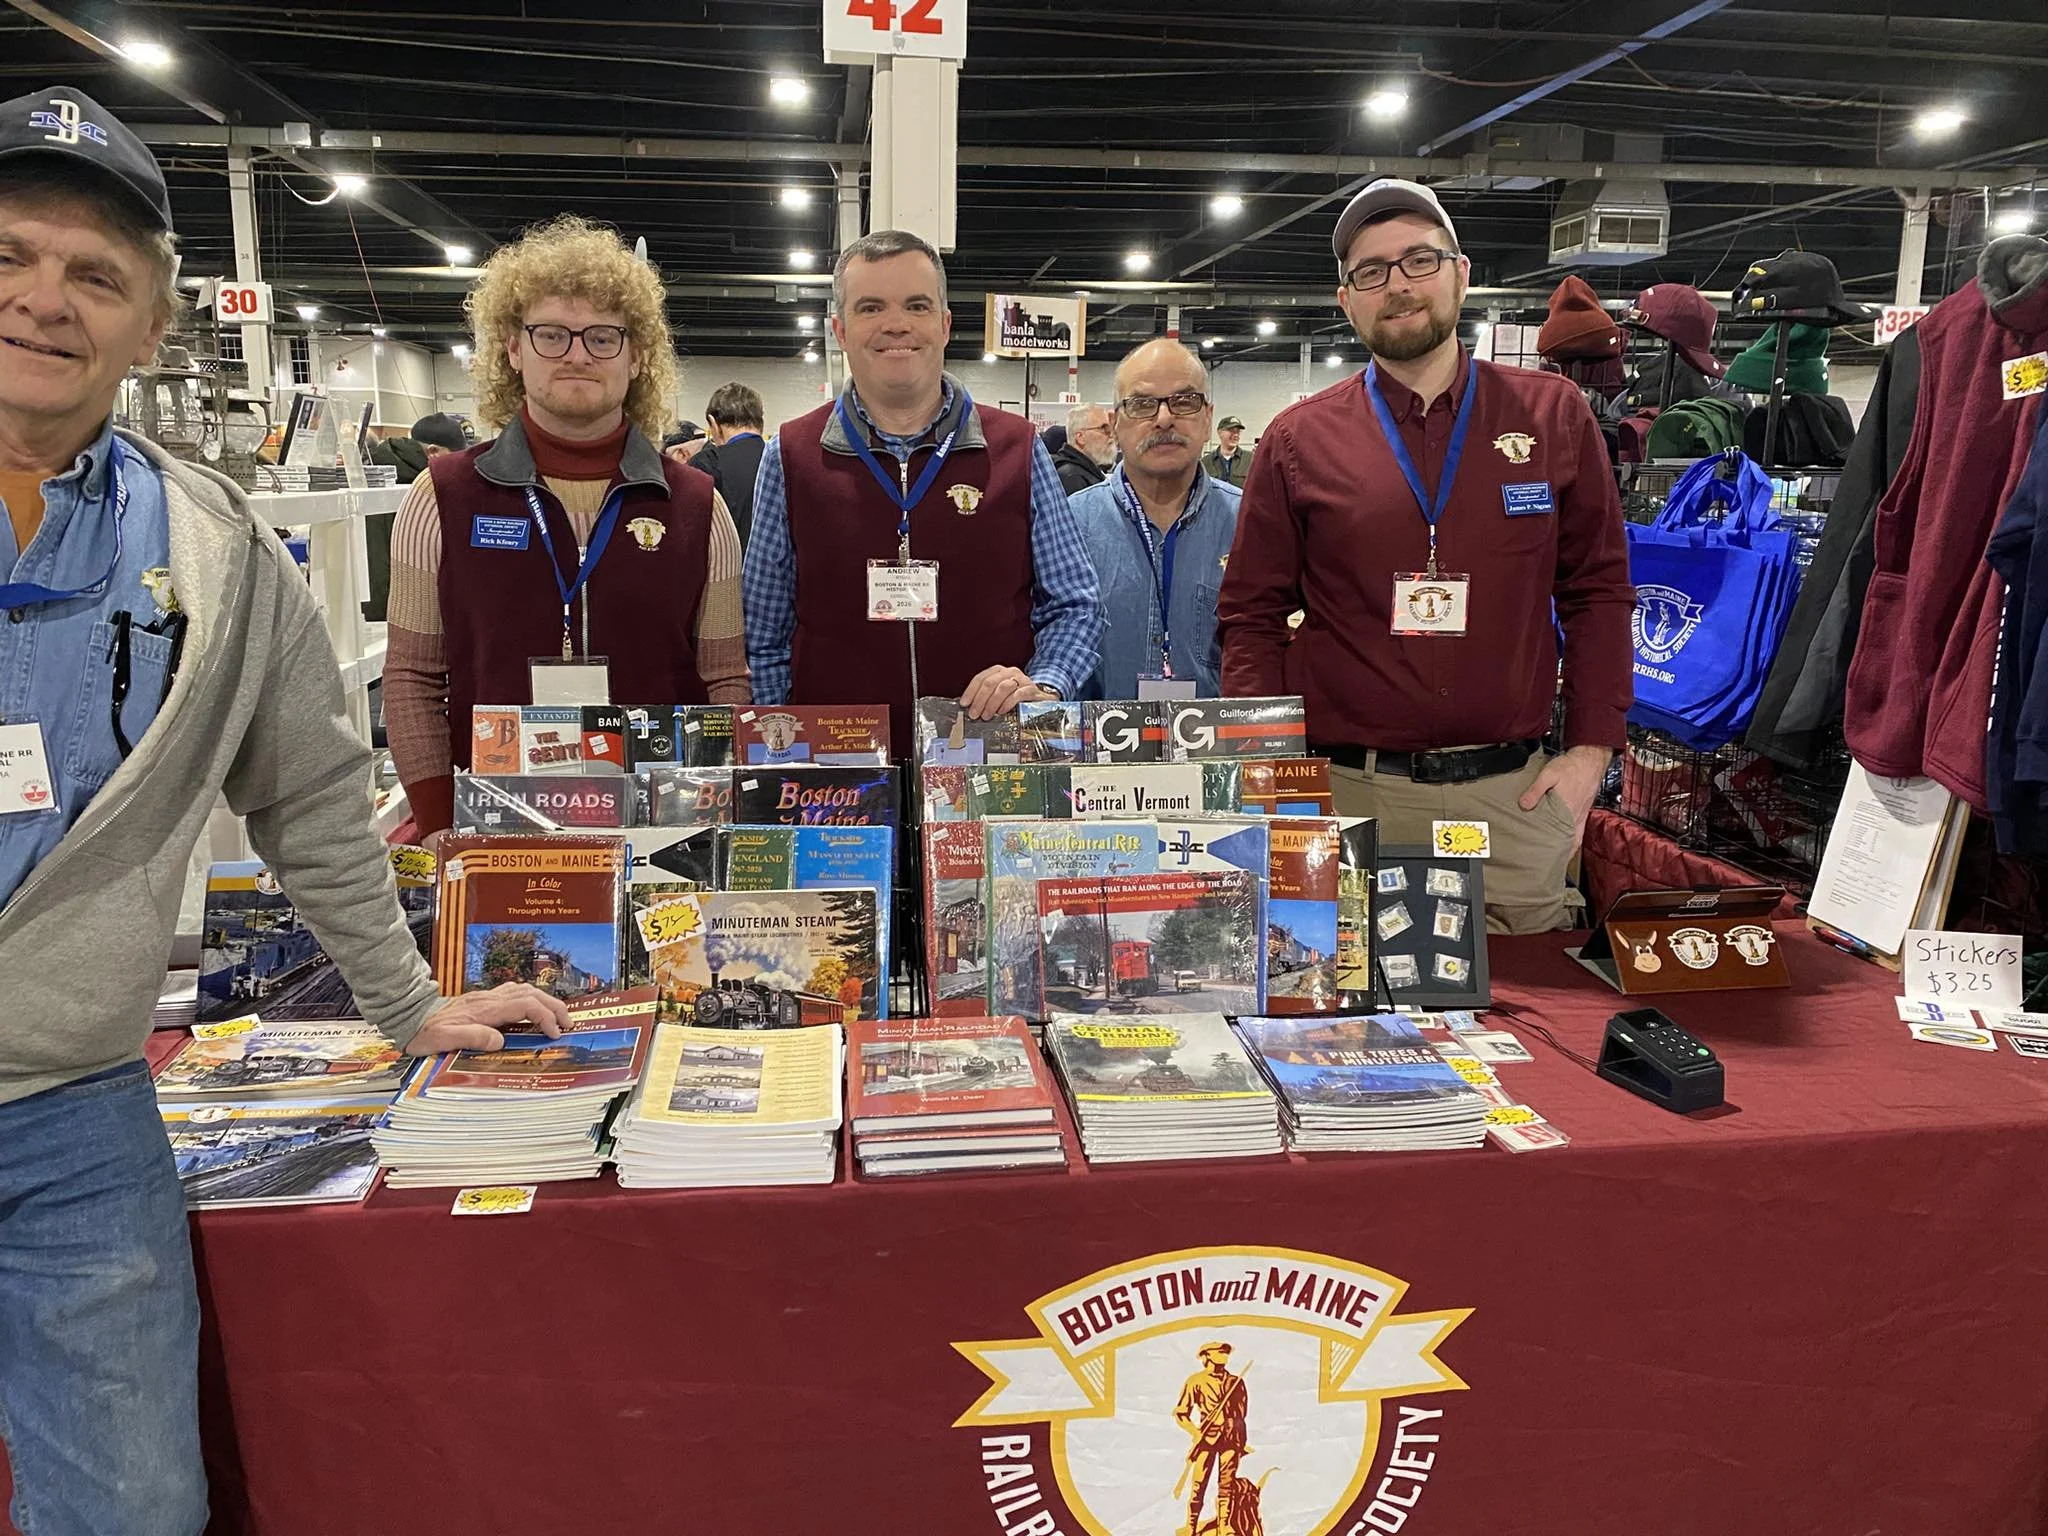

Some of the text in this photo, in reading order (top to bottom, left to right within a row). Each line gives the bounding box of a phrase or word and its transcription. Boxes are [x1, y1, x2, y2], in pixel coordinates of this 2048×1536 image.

[220, 289, 257, 314] 30
[1002, 337, 1069, 349] modelworks
[1638, 644, 1673, 664] HISTORICAL
[1674, 622, 1697, 655] SOCIETY
[598, 717, 622, 727] BAN
[817, 717, 880, 726] Boston & Maine
[1173, 707, 1254, 752] G Guilford
[533, 731, 561, 744] THE
[18, 749, 33, 757] RR
[1275, 766, 1318, 778] MAINE
[468, 792, 615, 808] IRON ROADS
[776, 782, 860, 810] Boston
[1074, 787, 1190, 813] Central Vermont
[491, 855, 542, 867] BOSTON
[562, 854, 599, 867] MAINE
[735, 854, 783, 863] ENGLAND
[527, 877, 562, 889] In Color
[1062, 887, 1102, 895] RAILROADS
[1104, 885, 1120, 893] THAT
[1122, 884, 1138, 892] RAN
[1139, 883, 1161, 891] ALONG
[1208, 880, 1221, 888] THE
[1280, 884, 1301, 892] Years
[508, 907, 542, 915] Through
[558, 907, 580, 915] Years
[711, 916, 836, 929] MINUTEMAN STEAM
[1916, 938, 2017, 966] Stickers
[1928, 971, 1993, 996] $3.25
[583, 998, 597, 1007] of
[600, 995, 621, 1004] the
[586, 1005, 645, 1018] MAINE
[260, 1030, 342, 1038] MINUTEMAN
[1075, 1031, 1174, 1039] VERMONT
[1328, 1051, 1367, 1060] PINE
[1370, 1049, 1415, 1057] TREES
[1342, 1055, 1438, 1066] MINUTEMEN
[269, 1108, 322, 1117] CALENDAR
[1058, 1267, 1379, 1347] BOSTON and MAINE
